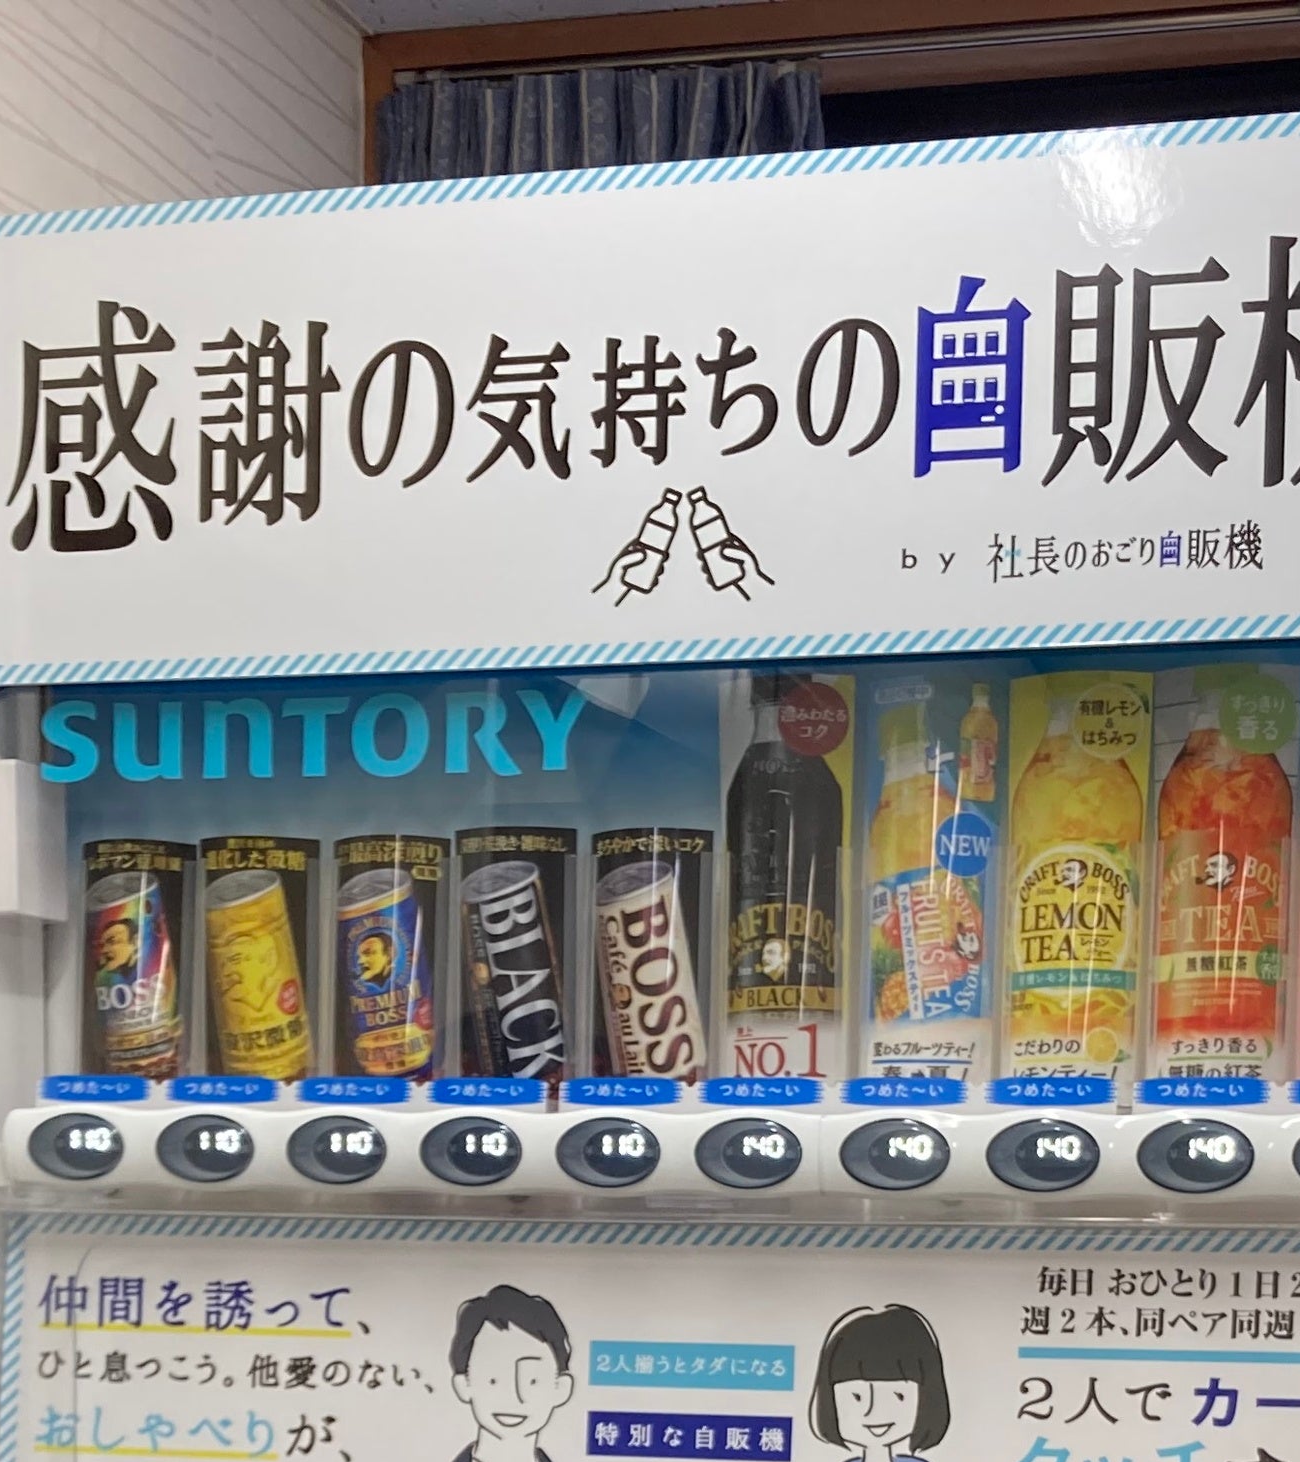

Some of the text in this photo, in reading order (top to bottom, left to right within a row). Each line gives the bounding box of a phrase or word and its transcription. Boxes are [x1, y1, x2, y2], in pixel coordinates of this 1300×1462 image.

[986, 522, 1264, 586] 社長のおごり自販機
[40, 688, 590, 784] SUNTORY
[1081, 729, 1137, 747] はちみつ
[1237, 716, 1280, 742] 香る
[939, 833, 992, 858] NEW
[1018, 861, 1132, 903] CRAFT BOSS
[1019, 900, 1126, 934] LEMON
[1179, 905, 1264, 944] TEA
[1020, 932, 1079, 965] TEA
[478, 885, 568, 1079] BLACK
[620, 895, 694, 1075] BOSS
[734, 1022, 828, 1079] NO.1
[1012, 1038, 1081, 1058] こだわりの
[1171, 1036, 1258, 1055] すっきり香る
[70, 1128, 111, 1150] 110
[201, 1130, 240, 1152] 110
[331, 1132, 372, 1154] 110
[466, 1133, 506, 1155] 110
[603, 1134, 644, 1156] 110
[744, 1135, 784, 1158] 140
[889, 1135, 932, 1160] 140
[1037, 1136, 1080, 1160] 140
[1189, 1136, 1235, 1162] 140
[1036, 1265, 1095, 1298] 毎日
[38, 1273, 372, 1337] 仲間を誘って、
[36, 1350, 436, 1394] ひと息つこう。他愛のない、
[595, 1350, 788, 1379] 2人揃うとタダになる
[593, 1420, 787, 1454] 特別な自販機
